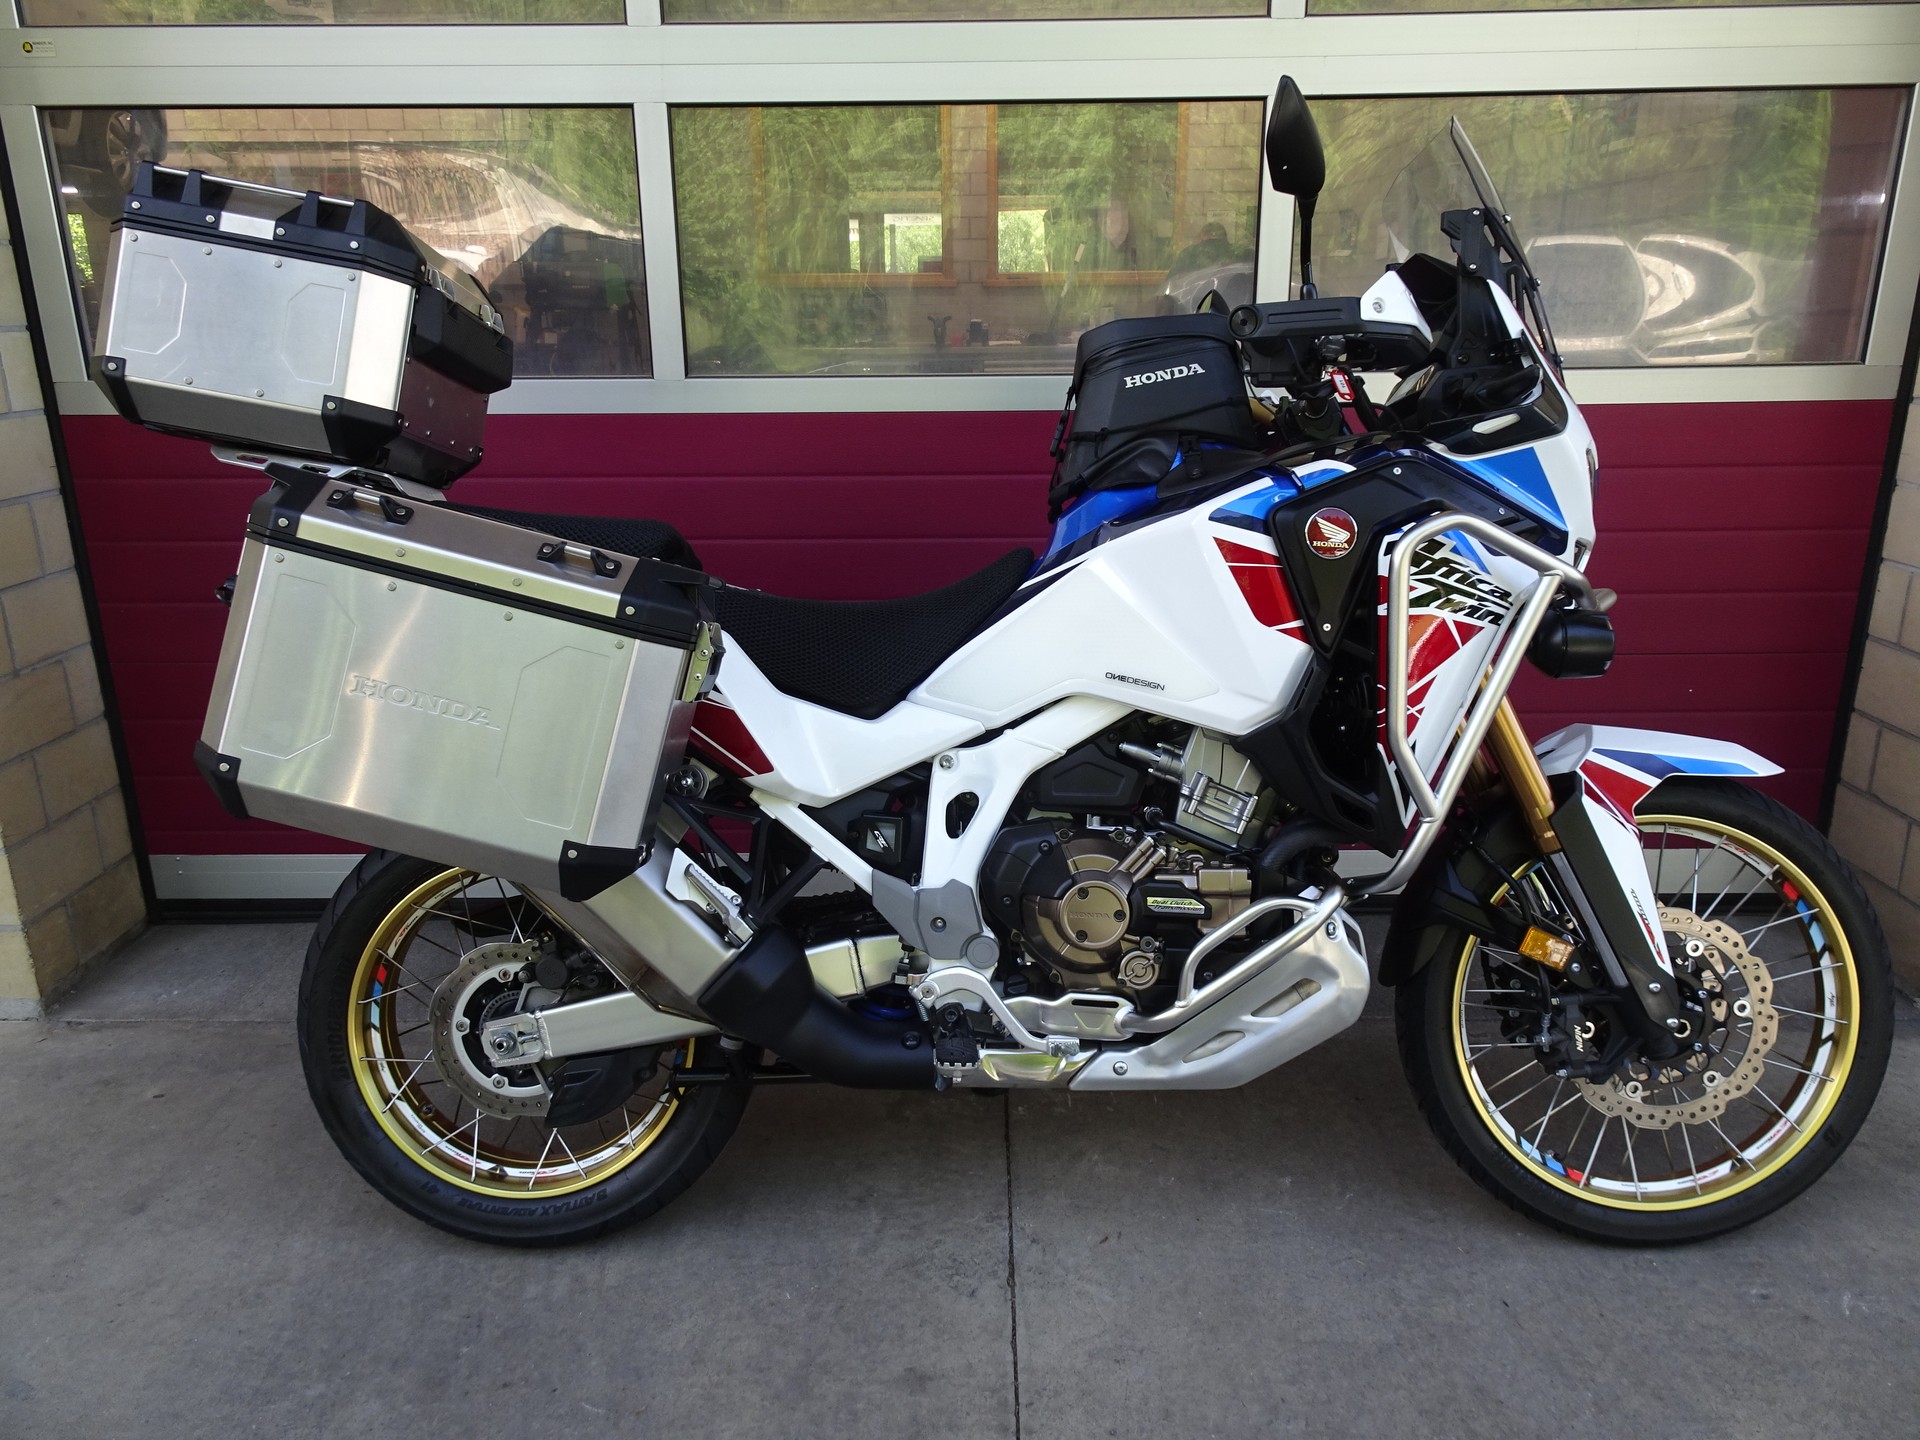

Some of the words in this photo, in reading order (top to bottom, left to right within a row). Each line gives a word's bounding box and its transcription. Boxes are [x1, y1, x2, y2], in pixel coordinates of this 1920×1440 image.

[1123, 363, 1206, 389] HONDA
[1312, 541, 1350, 549] HONDA
[1105, 672, 1165, 691] ONEDESIGN
[347, 674, 501, 731] HONDA
[1069, 911, 1111, 919] HONDA
